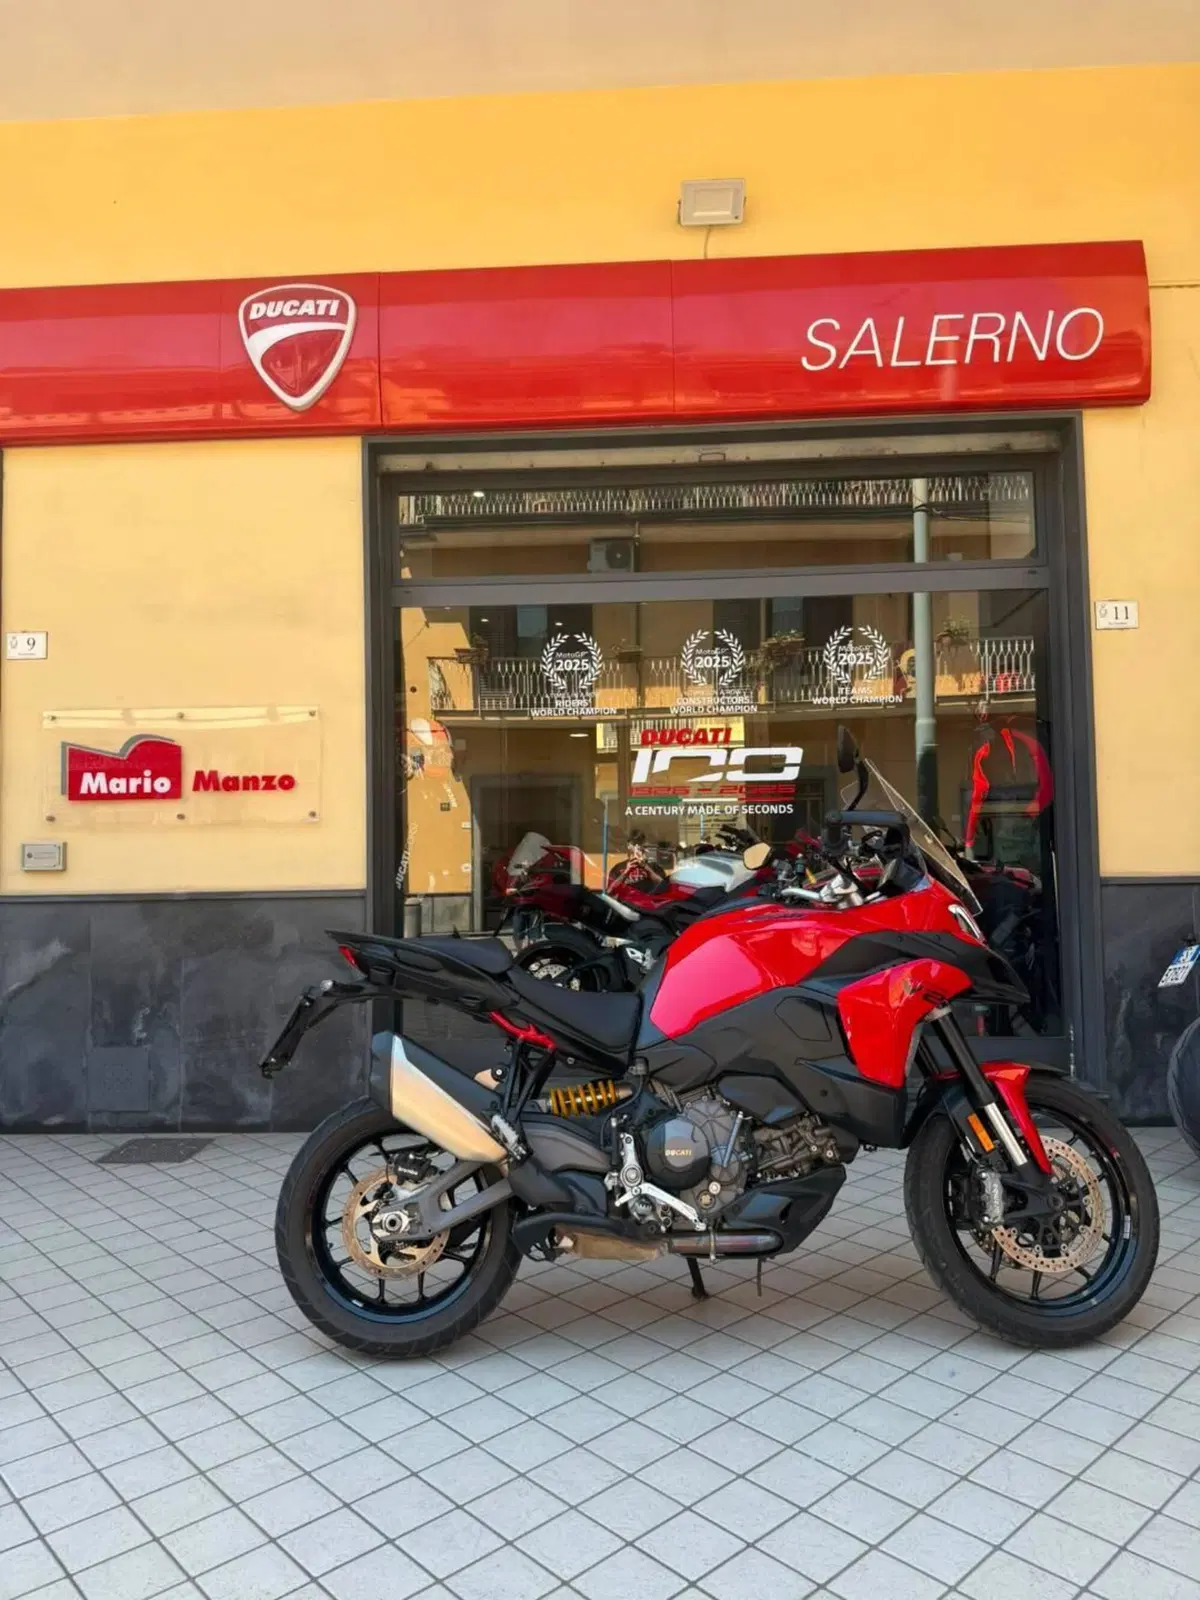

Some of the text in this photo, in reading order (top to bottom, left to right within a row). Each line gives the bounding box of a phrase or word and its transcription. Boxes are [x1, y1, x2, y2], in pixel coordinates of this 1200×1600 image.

[249, 299, 340, 320] DUCATI
[801, 307, 1104, 371] SALERNO
[1114, 605, 1129, 620] 11
[26, 637, 36, 651] 9
[555, 659, 589, 671] 2025
[695, 656, 729, 668] 2025
[839, 652, 874, 665] 2025
[812, 694, 903, 705] WORLD CHAMPION
[531, 706, 616, 717] WORLD CHAMPION
[670, 703, 758, 715] WORLD CHAMPION
[640, 727, 733, 746] DUCATI
[79, 769, 296, 794] Mario Manzo
[625, 804, 794, 816] A CENTURY MADE OF SECONDS
